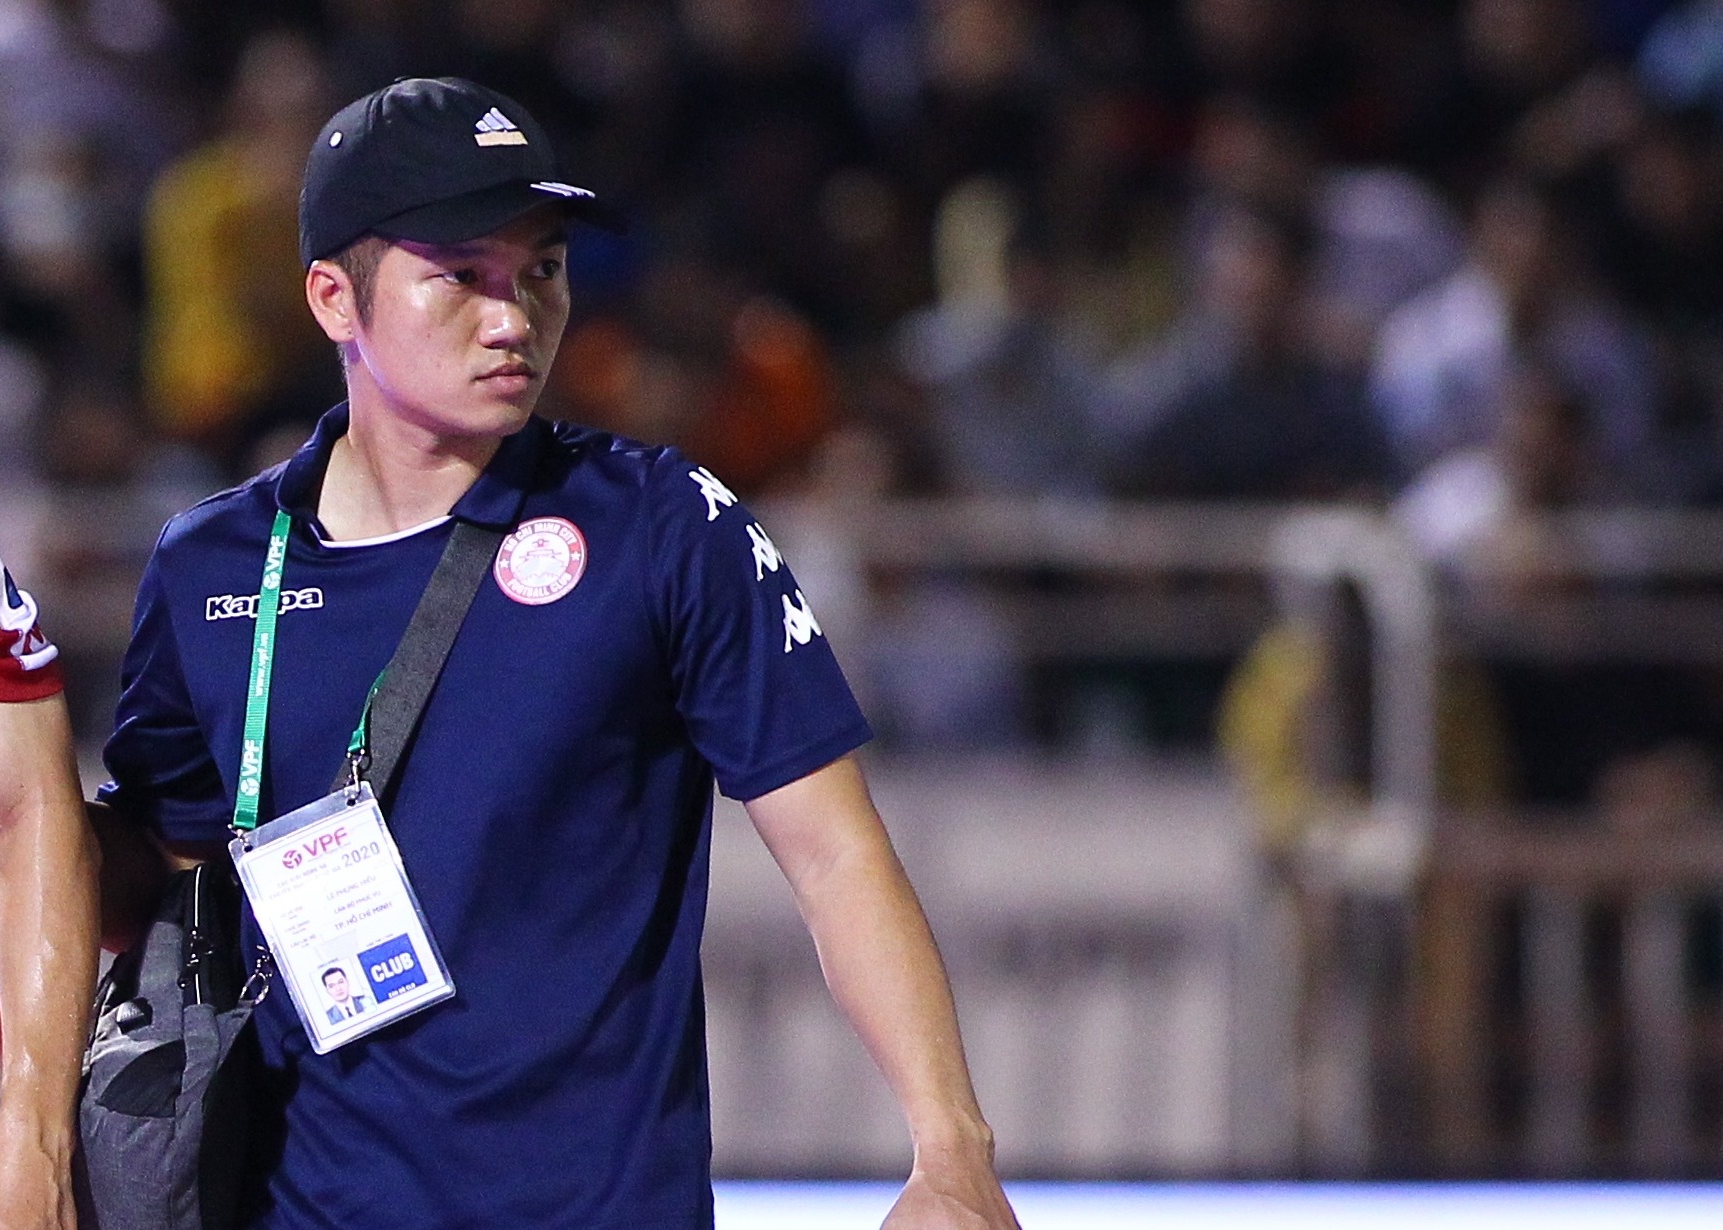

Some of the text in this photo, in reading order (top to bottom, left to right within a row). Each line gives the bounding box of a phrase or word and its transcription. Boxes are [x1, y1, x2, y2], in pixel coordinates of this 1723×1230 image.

[534, 523, 560, 535] MINH
[265, 535, 285, 571] VPF
[241, 740, 261, 777] VPF
[302, 827, 347, 856] VPF
[341, 841, 381, 867] 2020
[369, 951, 415, 983] CLUB
